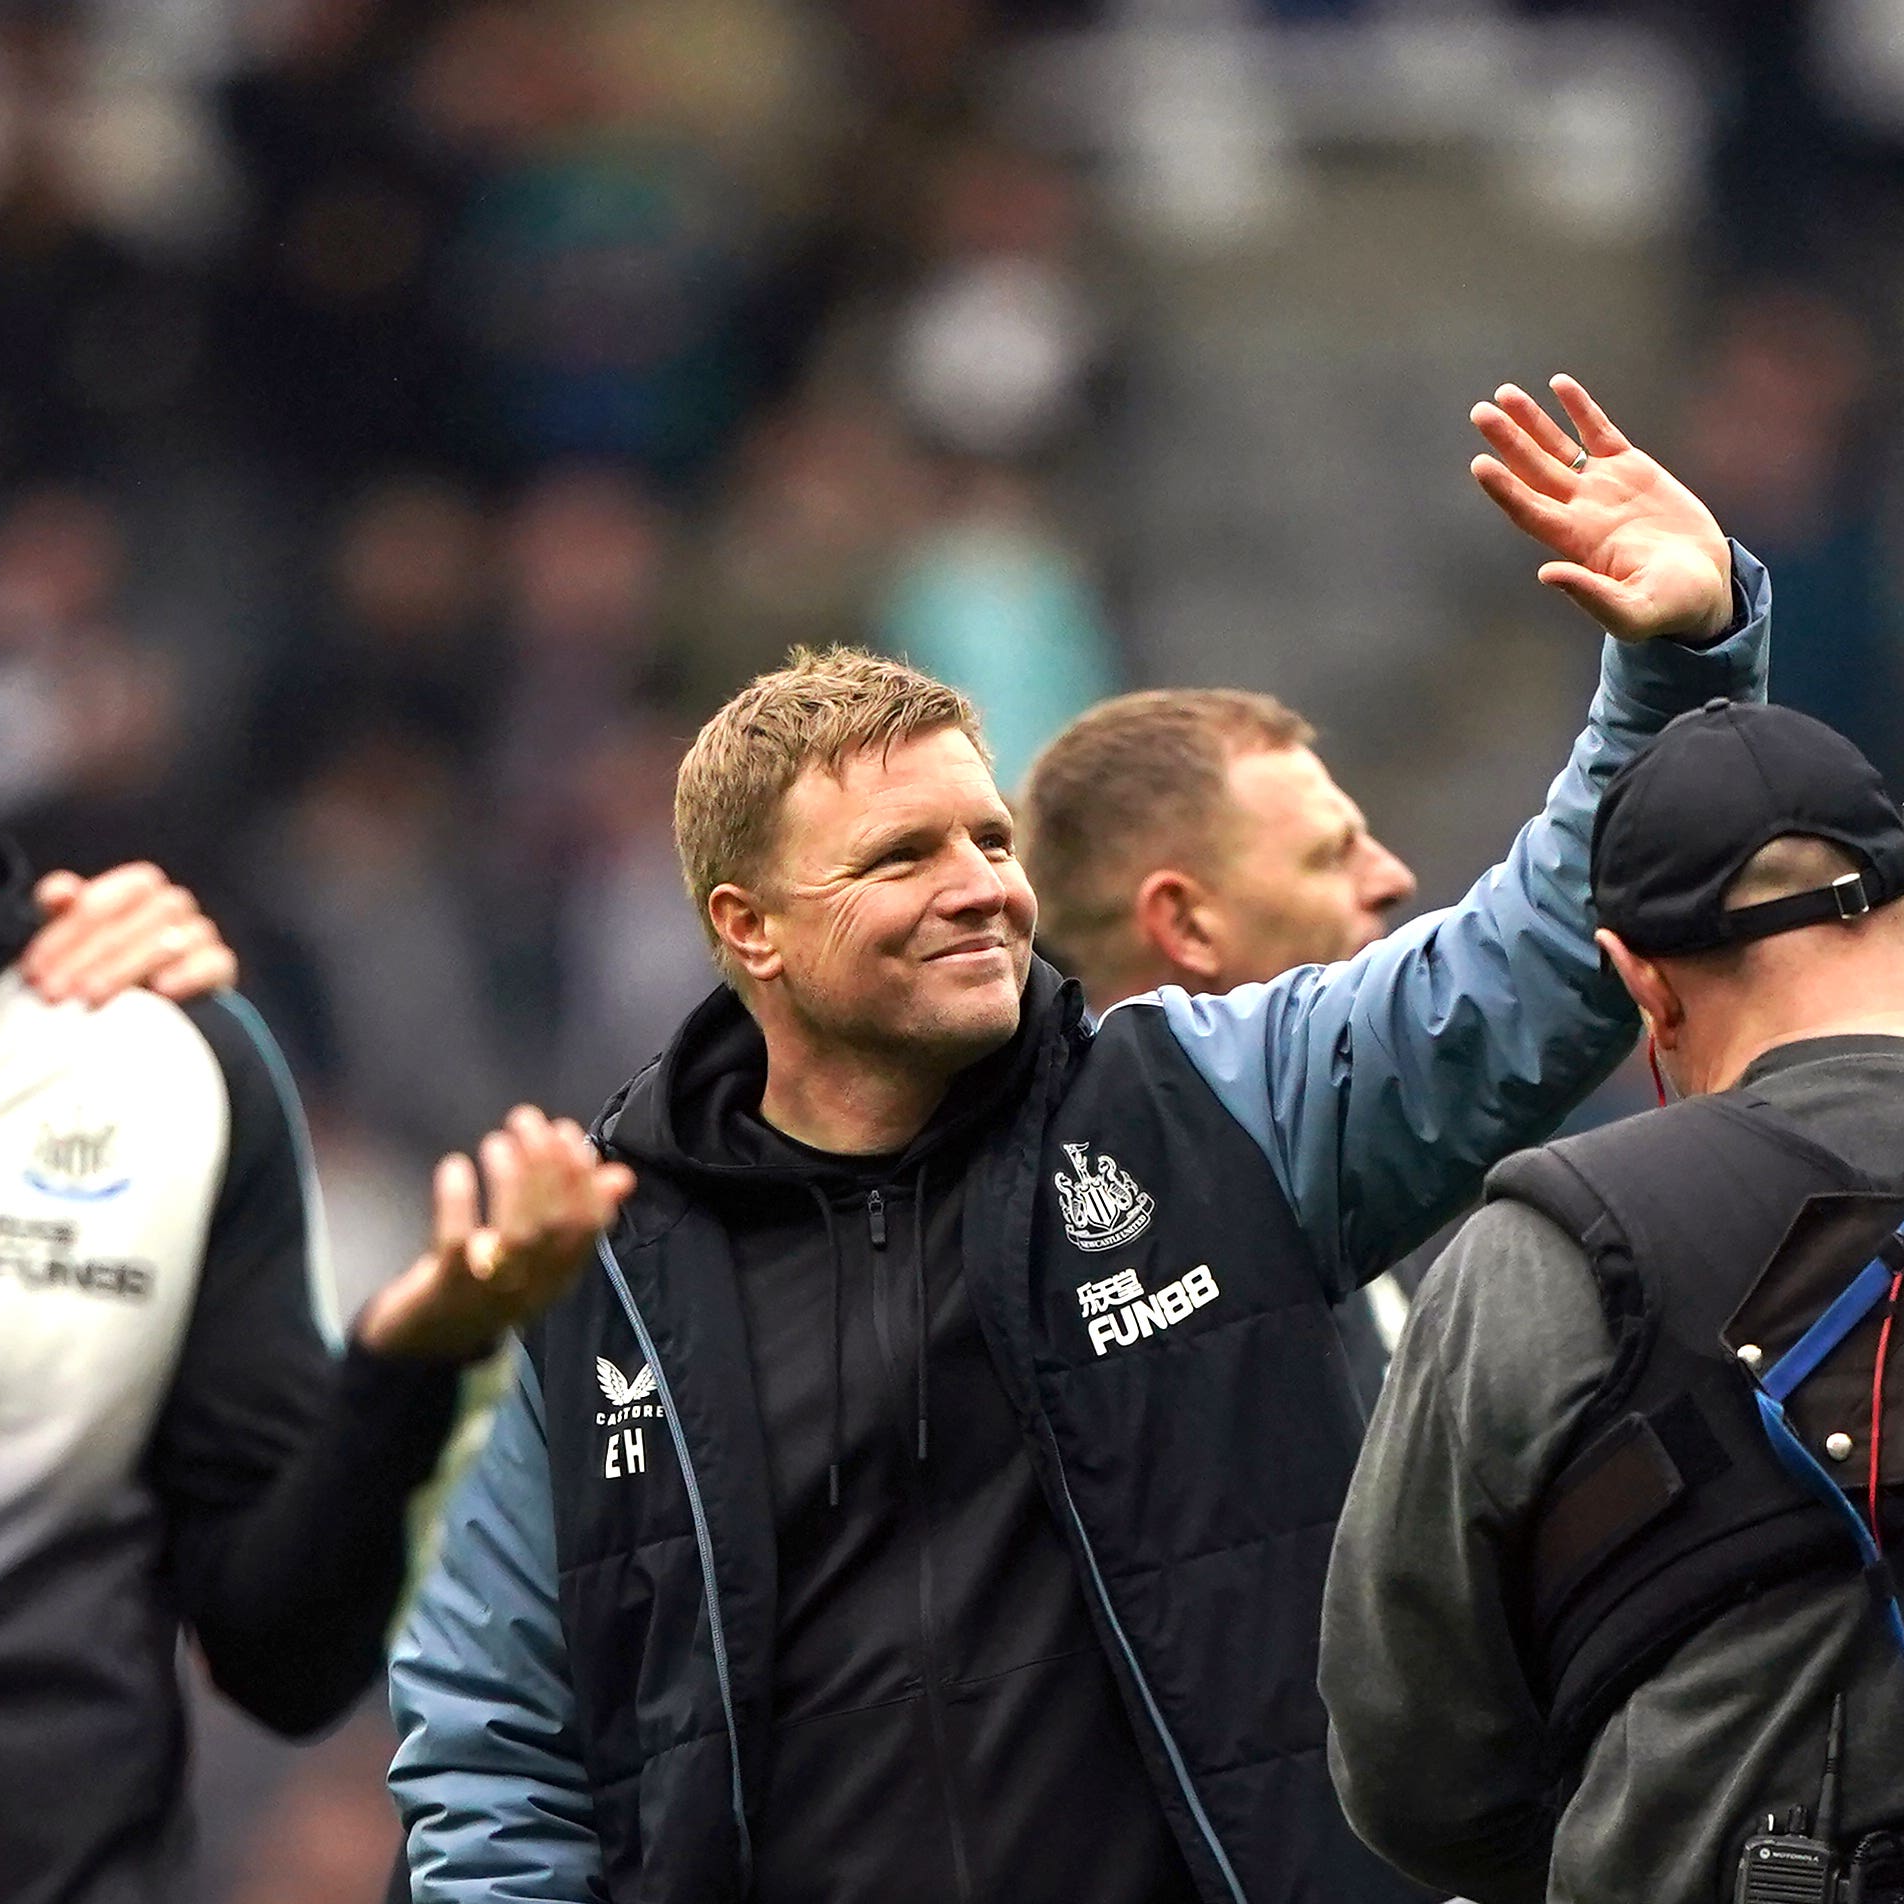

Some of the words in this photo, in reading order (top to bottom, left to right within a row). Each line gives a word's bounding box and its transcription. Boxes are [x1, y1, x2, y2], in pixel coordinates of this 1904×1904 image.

[1088, 1264, 1220, 1356] FUN88
[596, 1405, 664, 1426] CASTORE
[605, 1427, 646, 1479] EH
